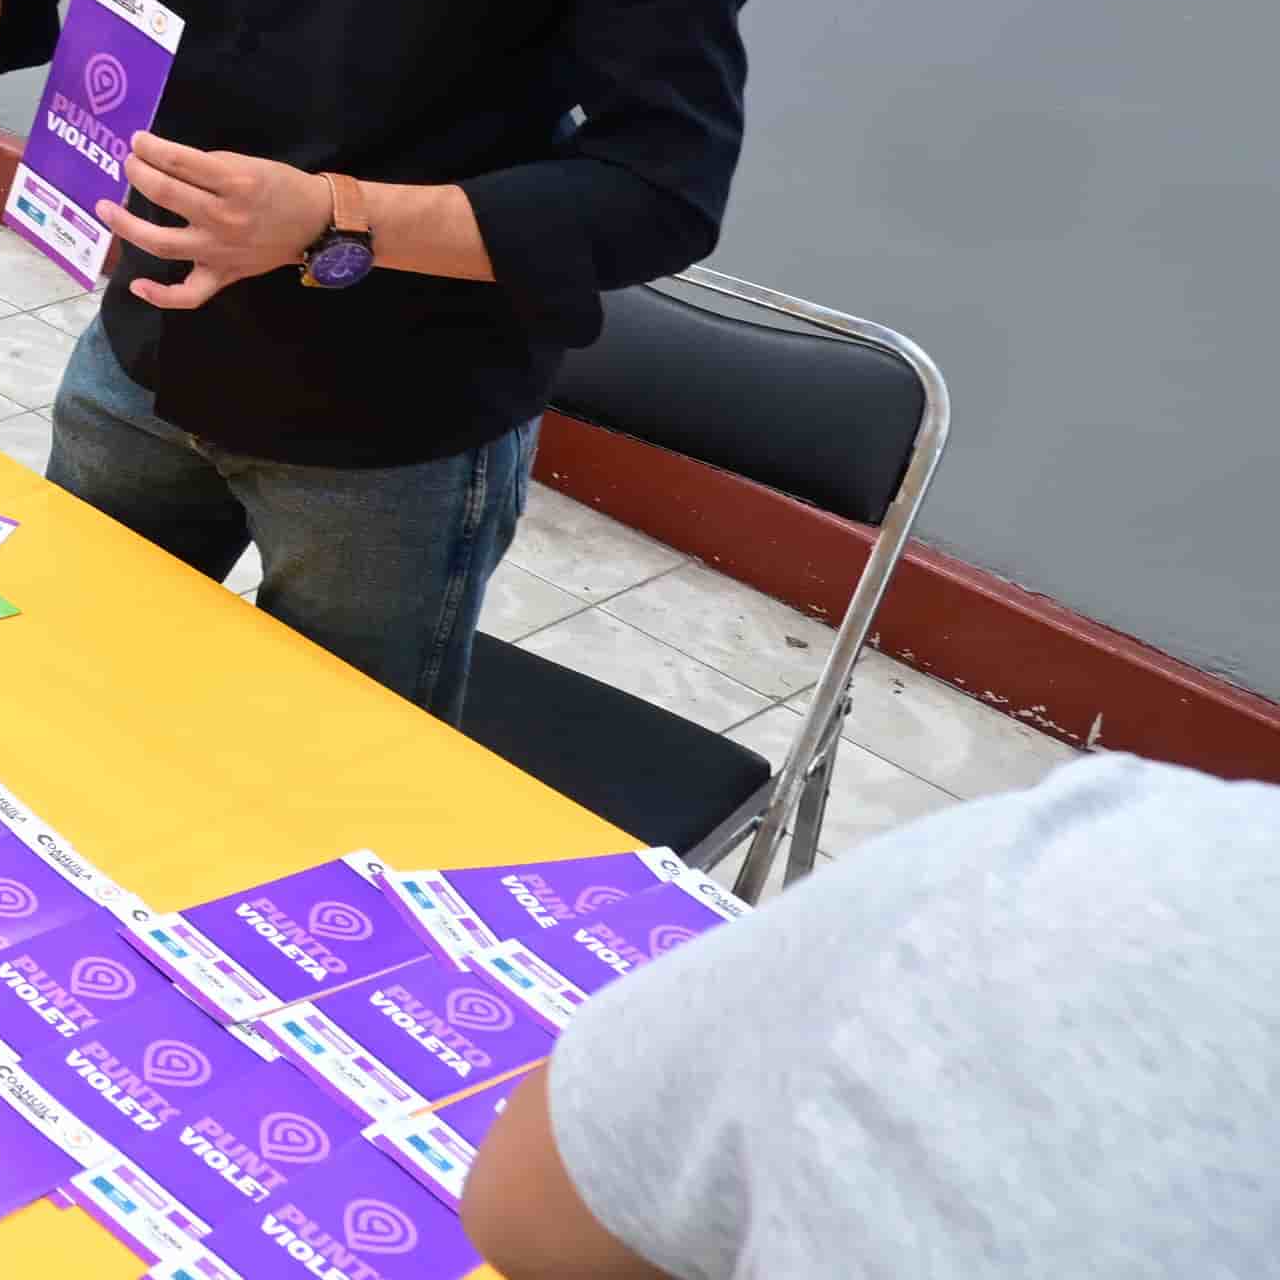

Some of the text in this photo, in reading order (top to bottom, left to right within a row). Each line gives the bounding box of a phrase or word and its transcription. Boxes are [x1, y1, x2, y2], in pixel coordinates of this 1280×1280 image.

[47, 110, 120, 183] VIOLETA
[50, 91, 128, 162] PUNTO
[235, 902, 328, 981] VIOLETA
[251, 897, 348, 973] PUNTO
[369, 991, 472, 1078] VIOLETA
[384, 984, 491, 1067] PUNTO
